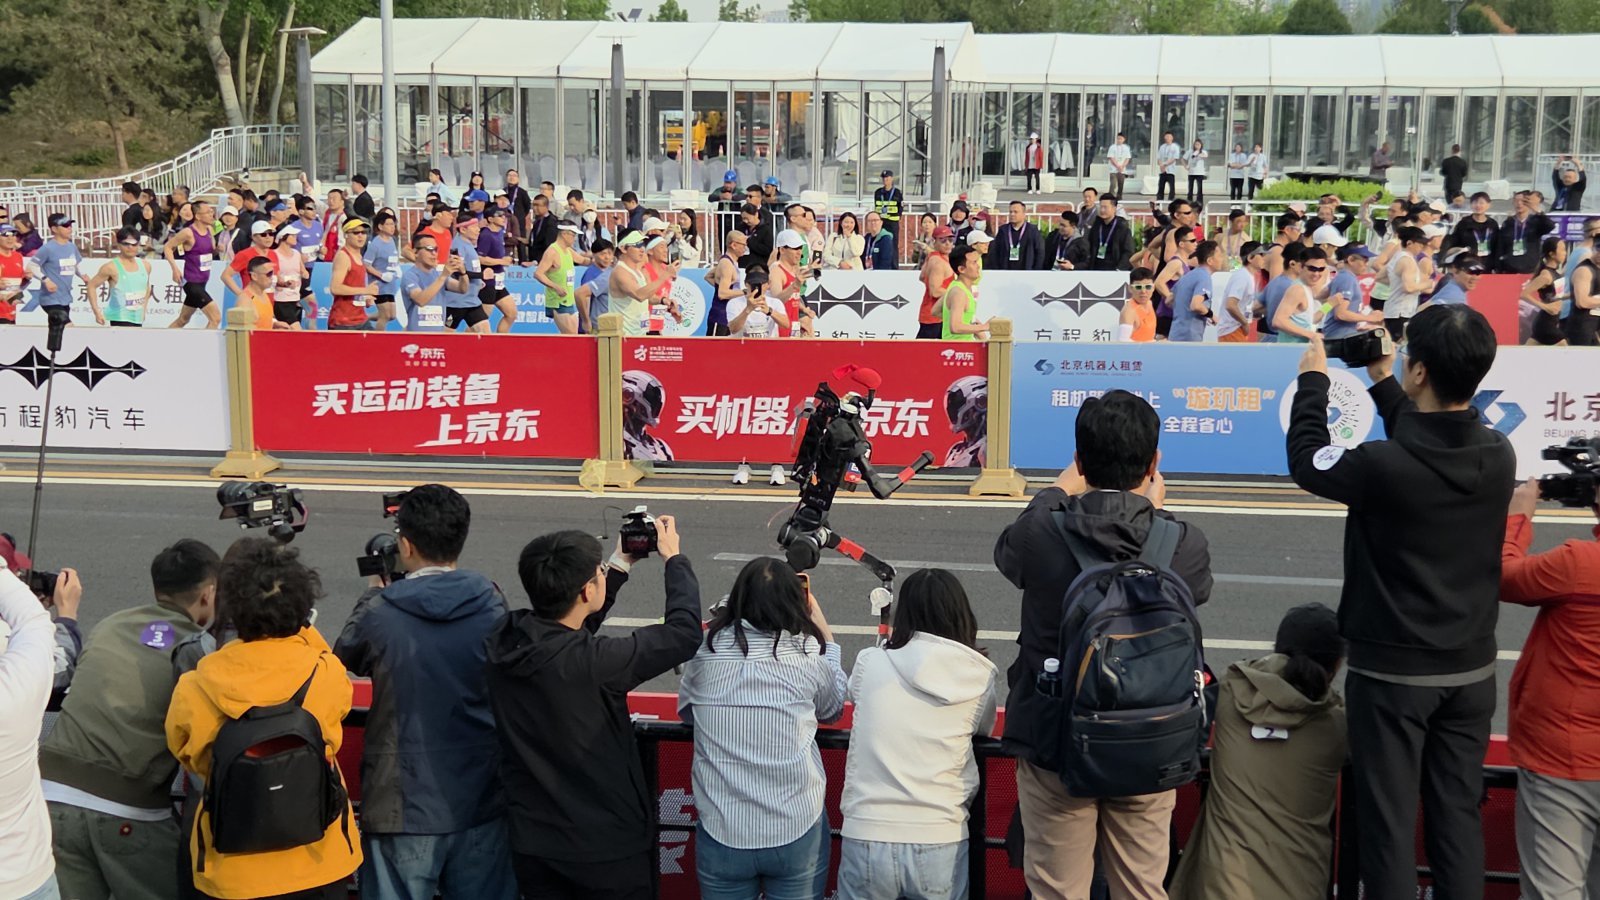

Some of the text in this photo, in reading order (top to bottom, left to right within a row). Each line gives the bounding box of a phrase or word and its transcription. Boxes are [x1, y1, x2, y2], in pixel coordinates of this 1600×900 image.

[420, 348, 446, 360] 京东
[1060, 359, 1143, 372] 北京机器人租赁
[312, 373, 501, 417] 买运动装备
[675, 394, 934, 440] 买机器京东
[1163, 416, 1233, 435] 全程省心
[415, 409, 541, 448] 上京东
[152, 631, 163, 642] 3
